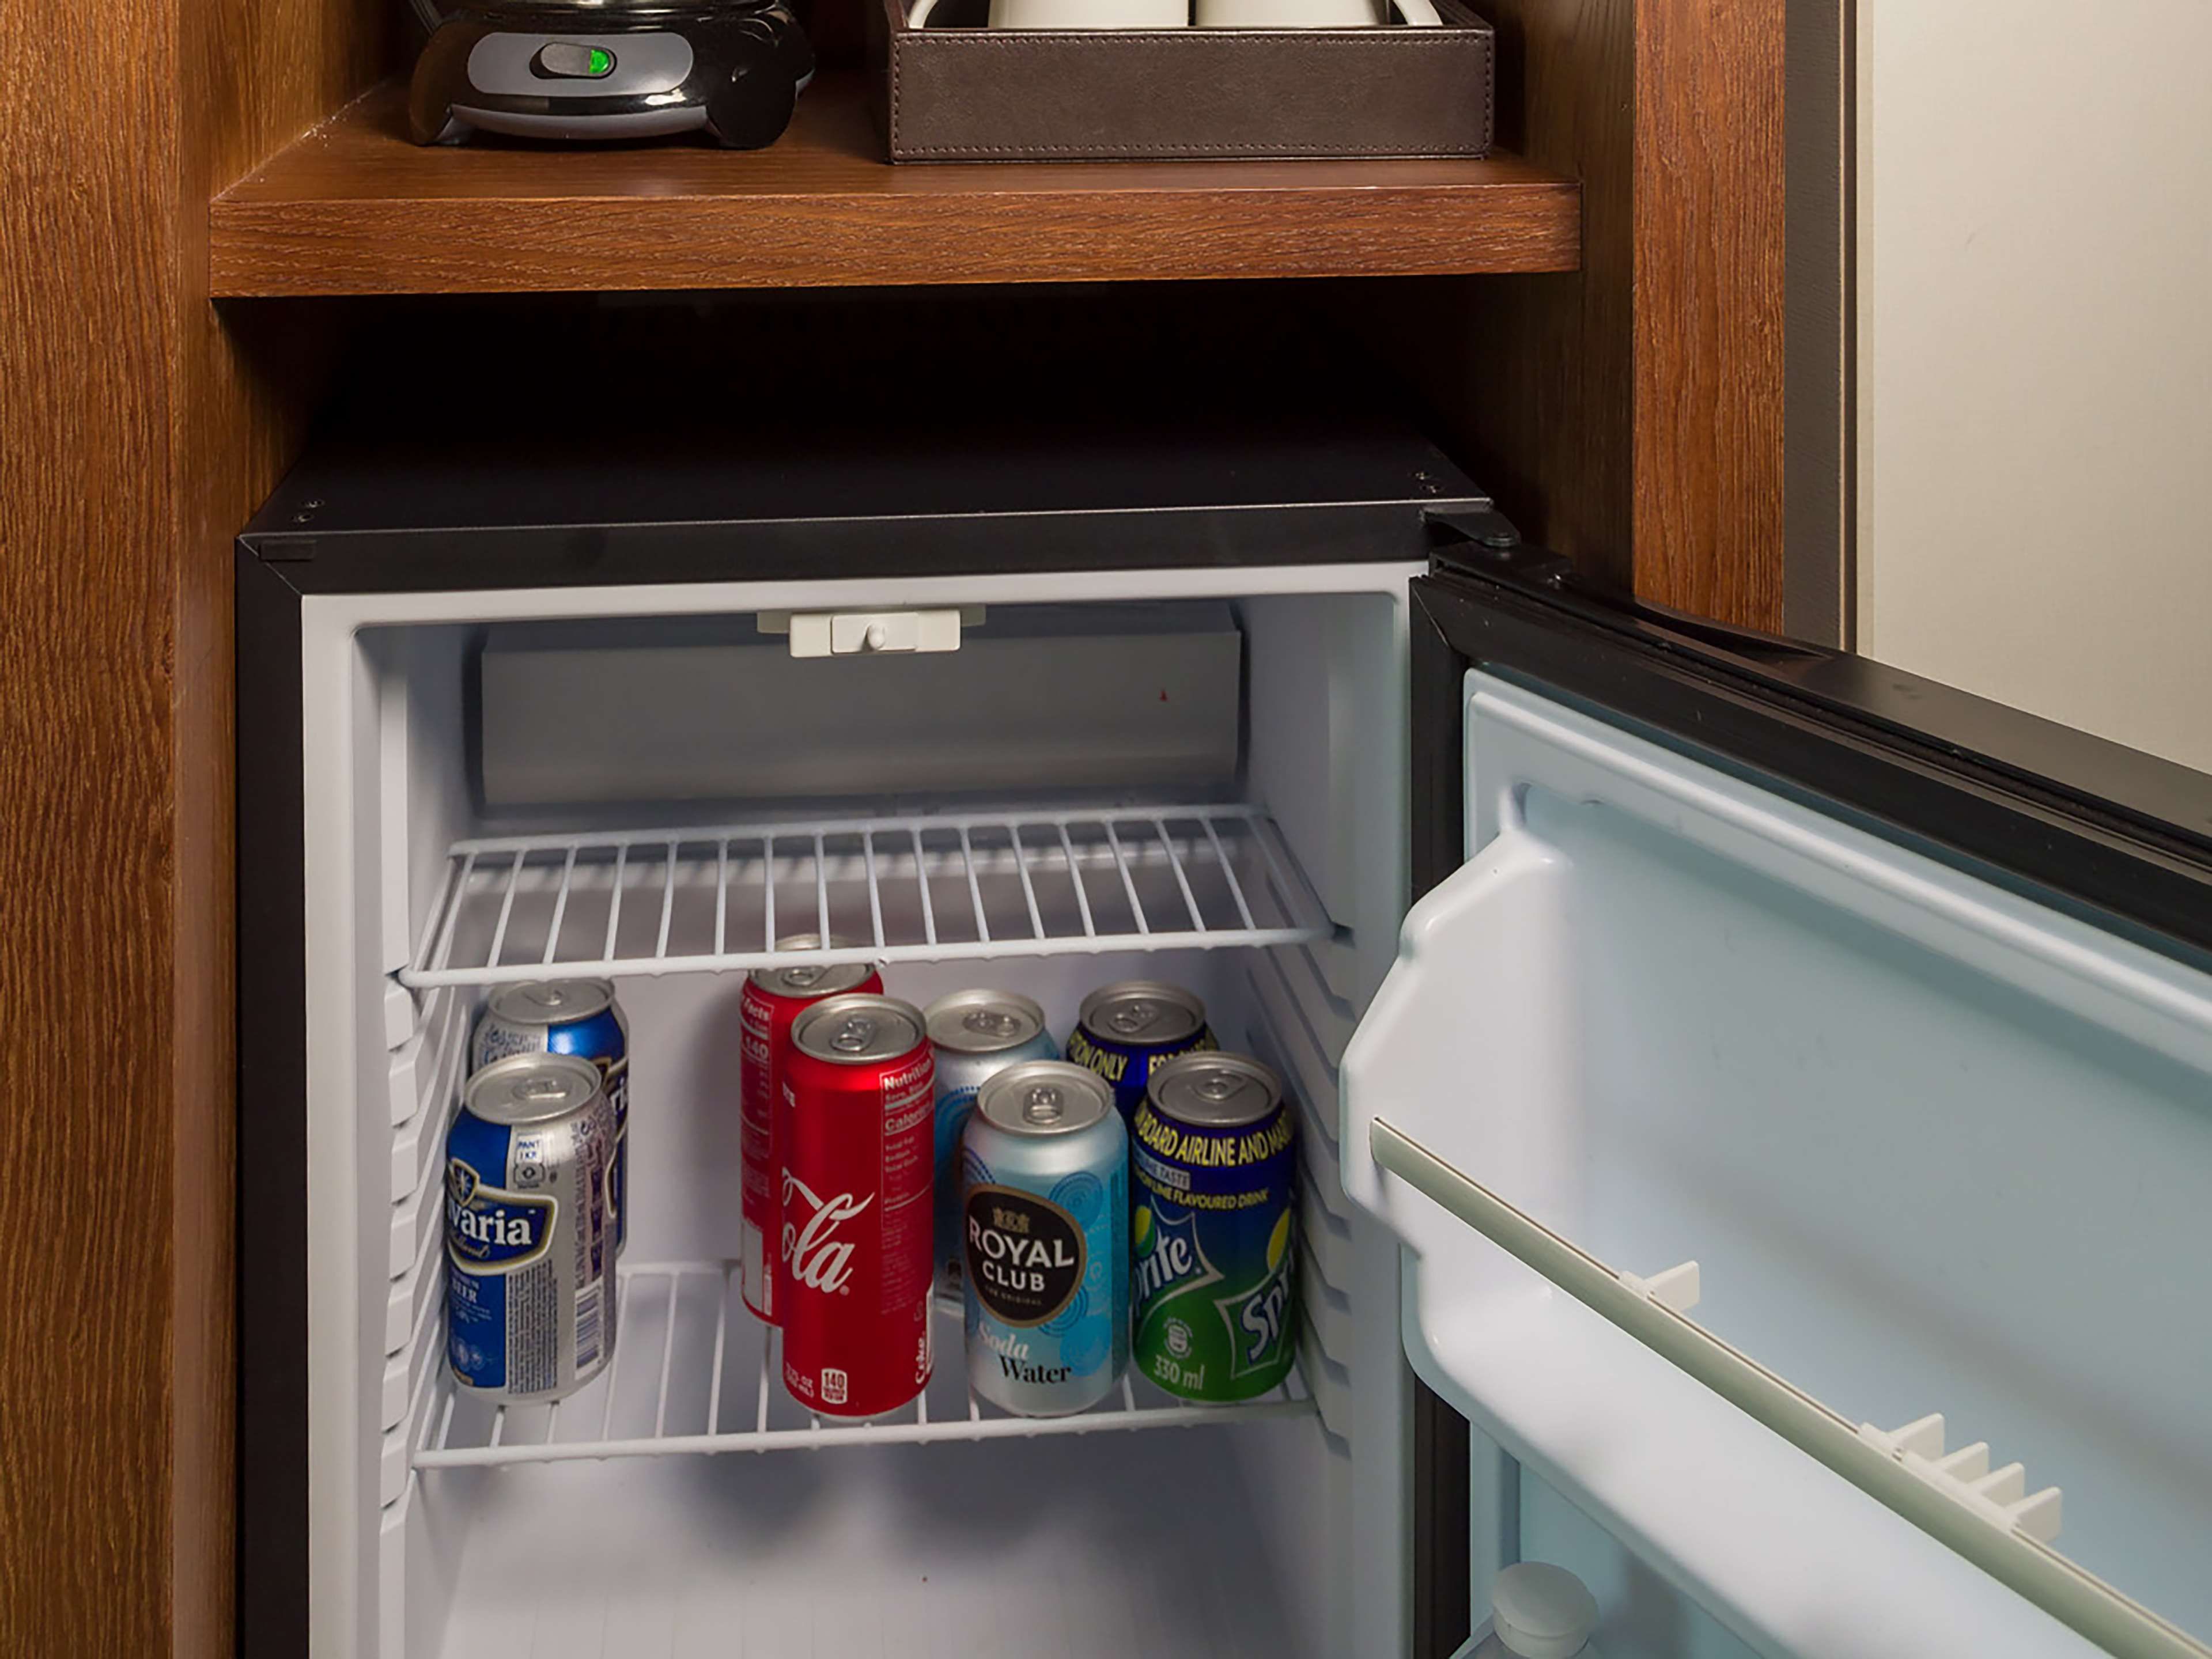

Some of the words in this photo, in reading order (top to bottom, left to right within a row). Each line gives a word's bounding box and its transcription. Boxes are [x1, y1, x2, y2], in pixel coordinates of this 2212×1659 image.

[1090, 1049, 1128, 1081] ONLY
[1139, 1113, 1179, 1157] BOARD
[1174, 1134, 1237, 1167] AIRLINE
[1239, 1131, 1269, 1165] AND
[1160, 1166, 1189, 1188] TASTE
[1173, 1188, 1238, 1210] FLAVOURED
[1239, 1187, 1269, 1208] DRINK
[969, 1214, 1075, 1268] ROYAL
[982, 1259, 1046, 1292] CLUB
[979, 1321, 1030, 1361] Soda
[823, 1371, 845, 1389] 140
[998, 1354, 1072, 1384] Water
[1154, 1354, 1181, 1384] 330
[1183, 1364, 1205, 1391] ml
